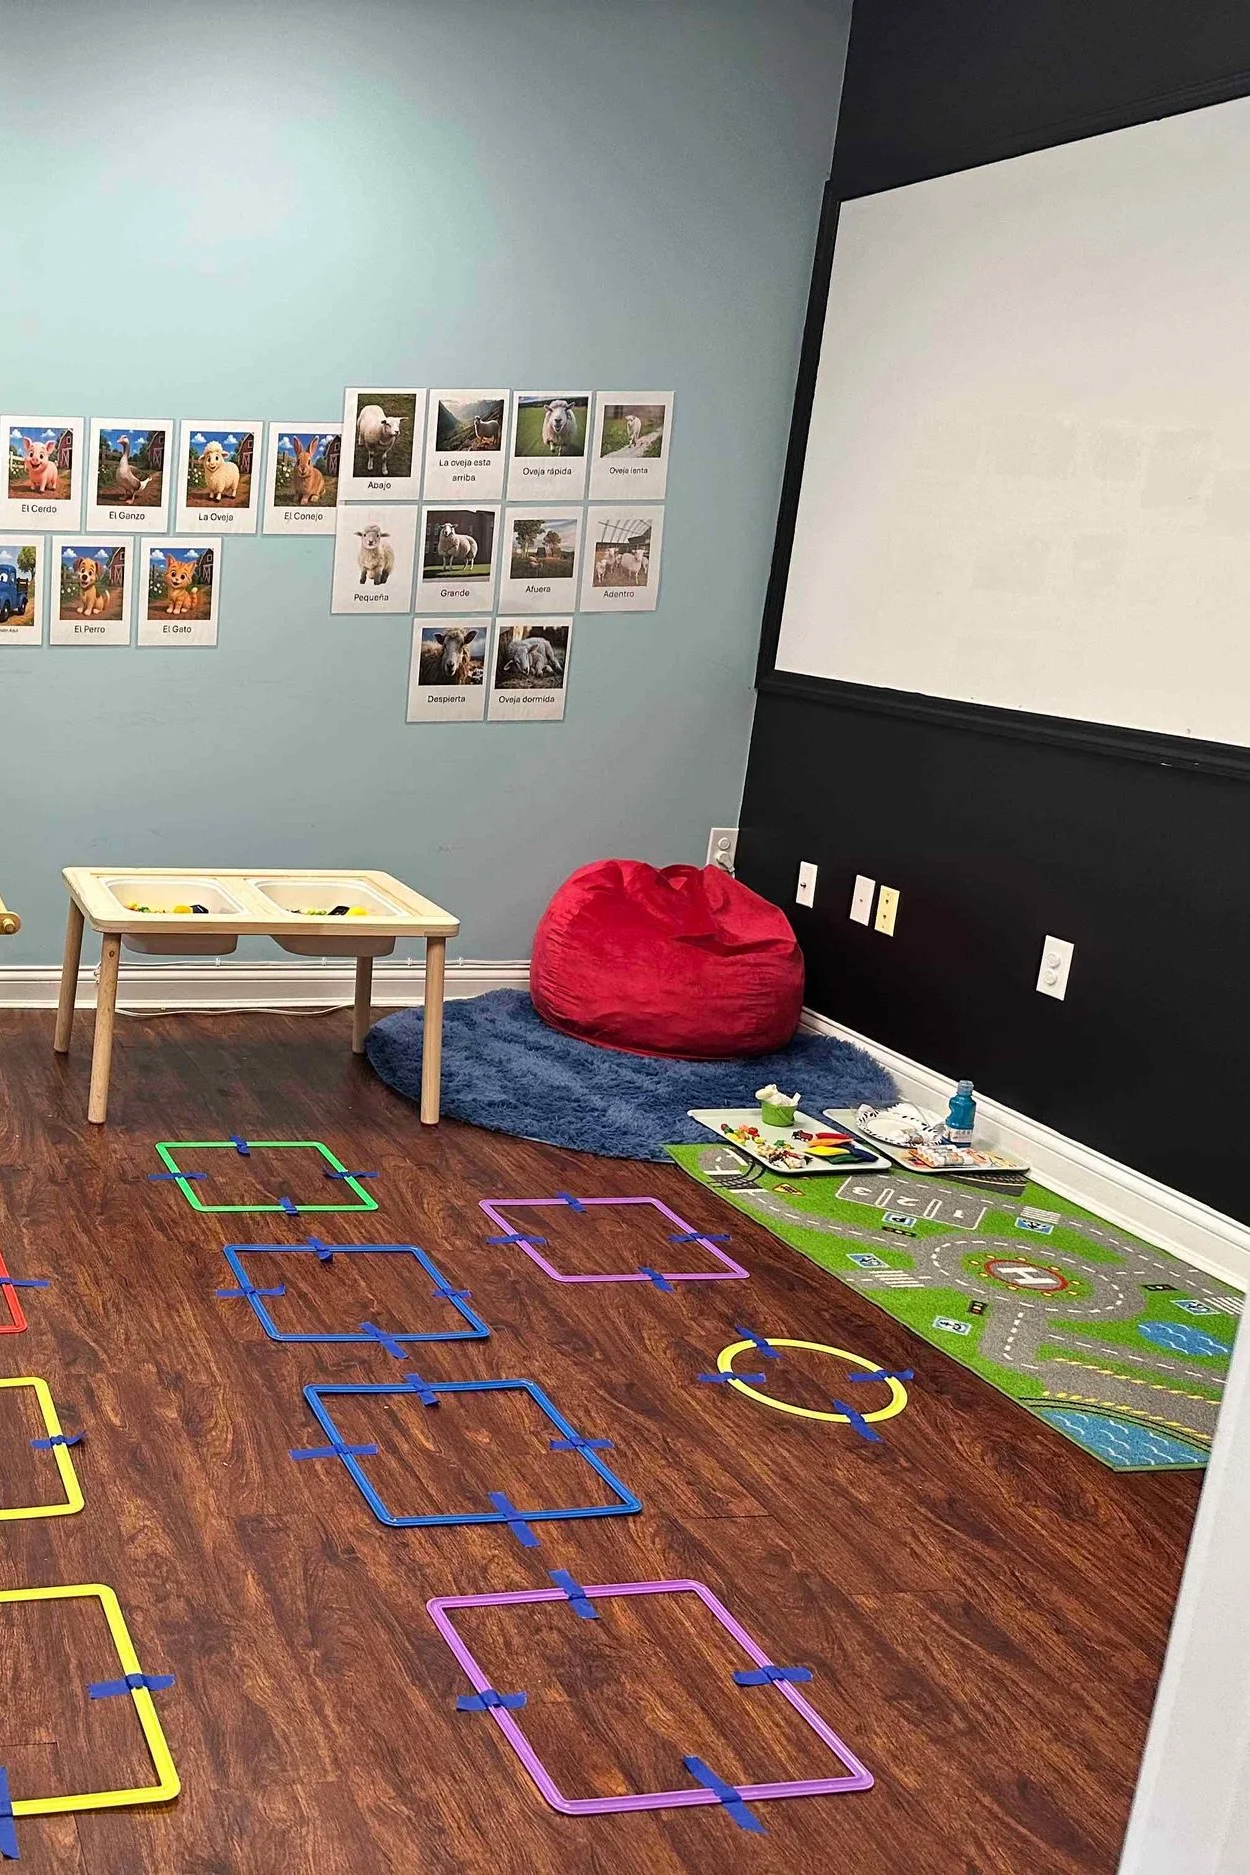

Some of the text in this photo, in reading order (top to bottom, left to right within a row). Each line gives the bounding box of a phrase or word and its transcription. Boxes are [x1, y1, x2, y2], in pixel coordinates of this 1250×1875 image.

[438, 458, 491, 469] La oveja esta
[522, 467, 572, 477] Oveja rápida
[608, 466, 649, 476] Oveja lenta
[451, 473, 476, 482] arriba
[367, 481, 392, 491] Abajo
[21, 503, 58, 514] El Cerdo
[108, 510, 146, 521] El Ganzo
[198, 512, 234, 523] La Oveja
[283, 511, 324, 522] El Conejo
[440, 588, 470, 598] Grande
[525, 585, 551, 593] Afuera
[602, 590, 635, 598] Adentro
[353, 593, 389, 603] Pequeña
[74, 624, 106, 634] El Perro
[162, 624, 192, 634] El Gato
[427, 695, 466, 705] Despierta
[498, 695, 555, 705] Oveja dormida
[996, 1266, 1058, 1285] H
